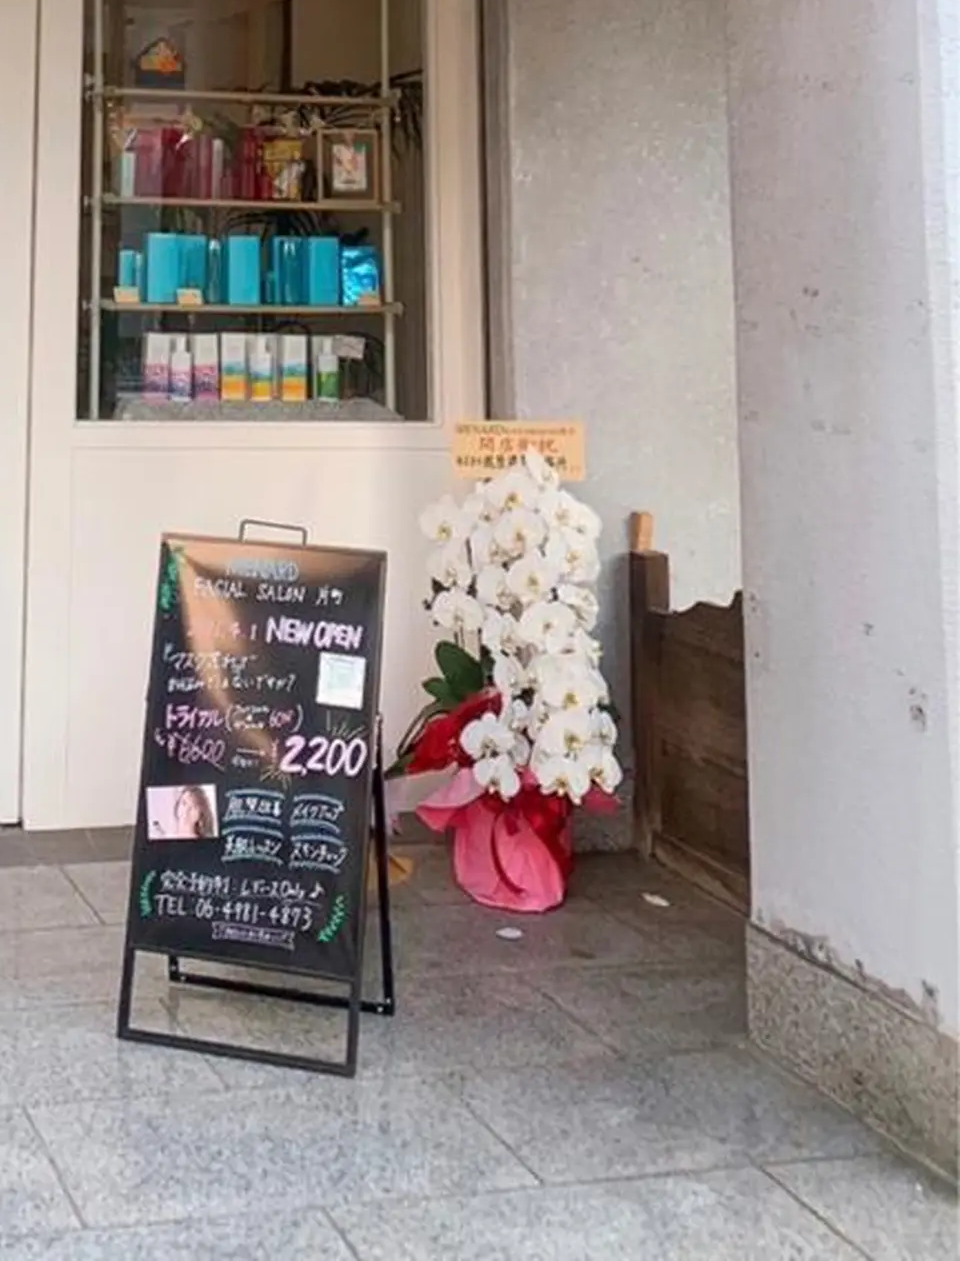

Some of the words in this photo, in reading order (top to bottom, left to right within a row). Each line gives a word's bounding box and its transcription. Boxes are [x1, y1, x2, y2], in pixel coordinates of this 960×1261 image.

[193, 579, 246, 600] FACIAL
[256, 583, 306, 603] SALON
[266, 616, 315, 646] NEW
[314, 621, 364, 650] OPEN
[155, 893, 187, 916] TEL
